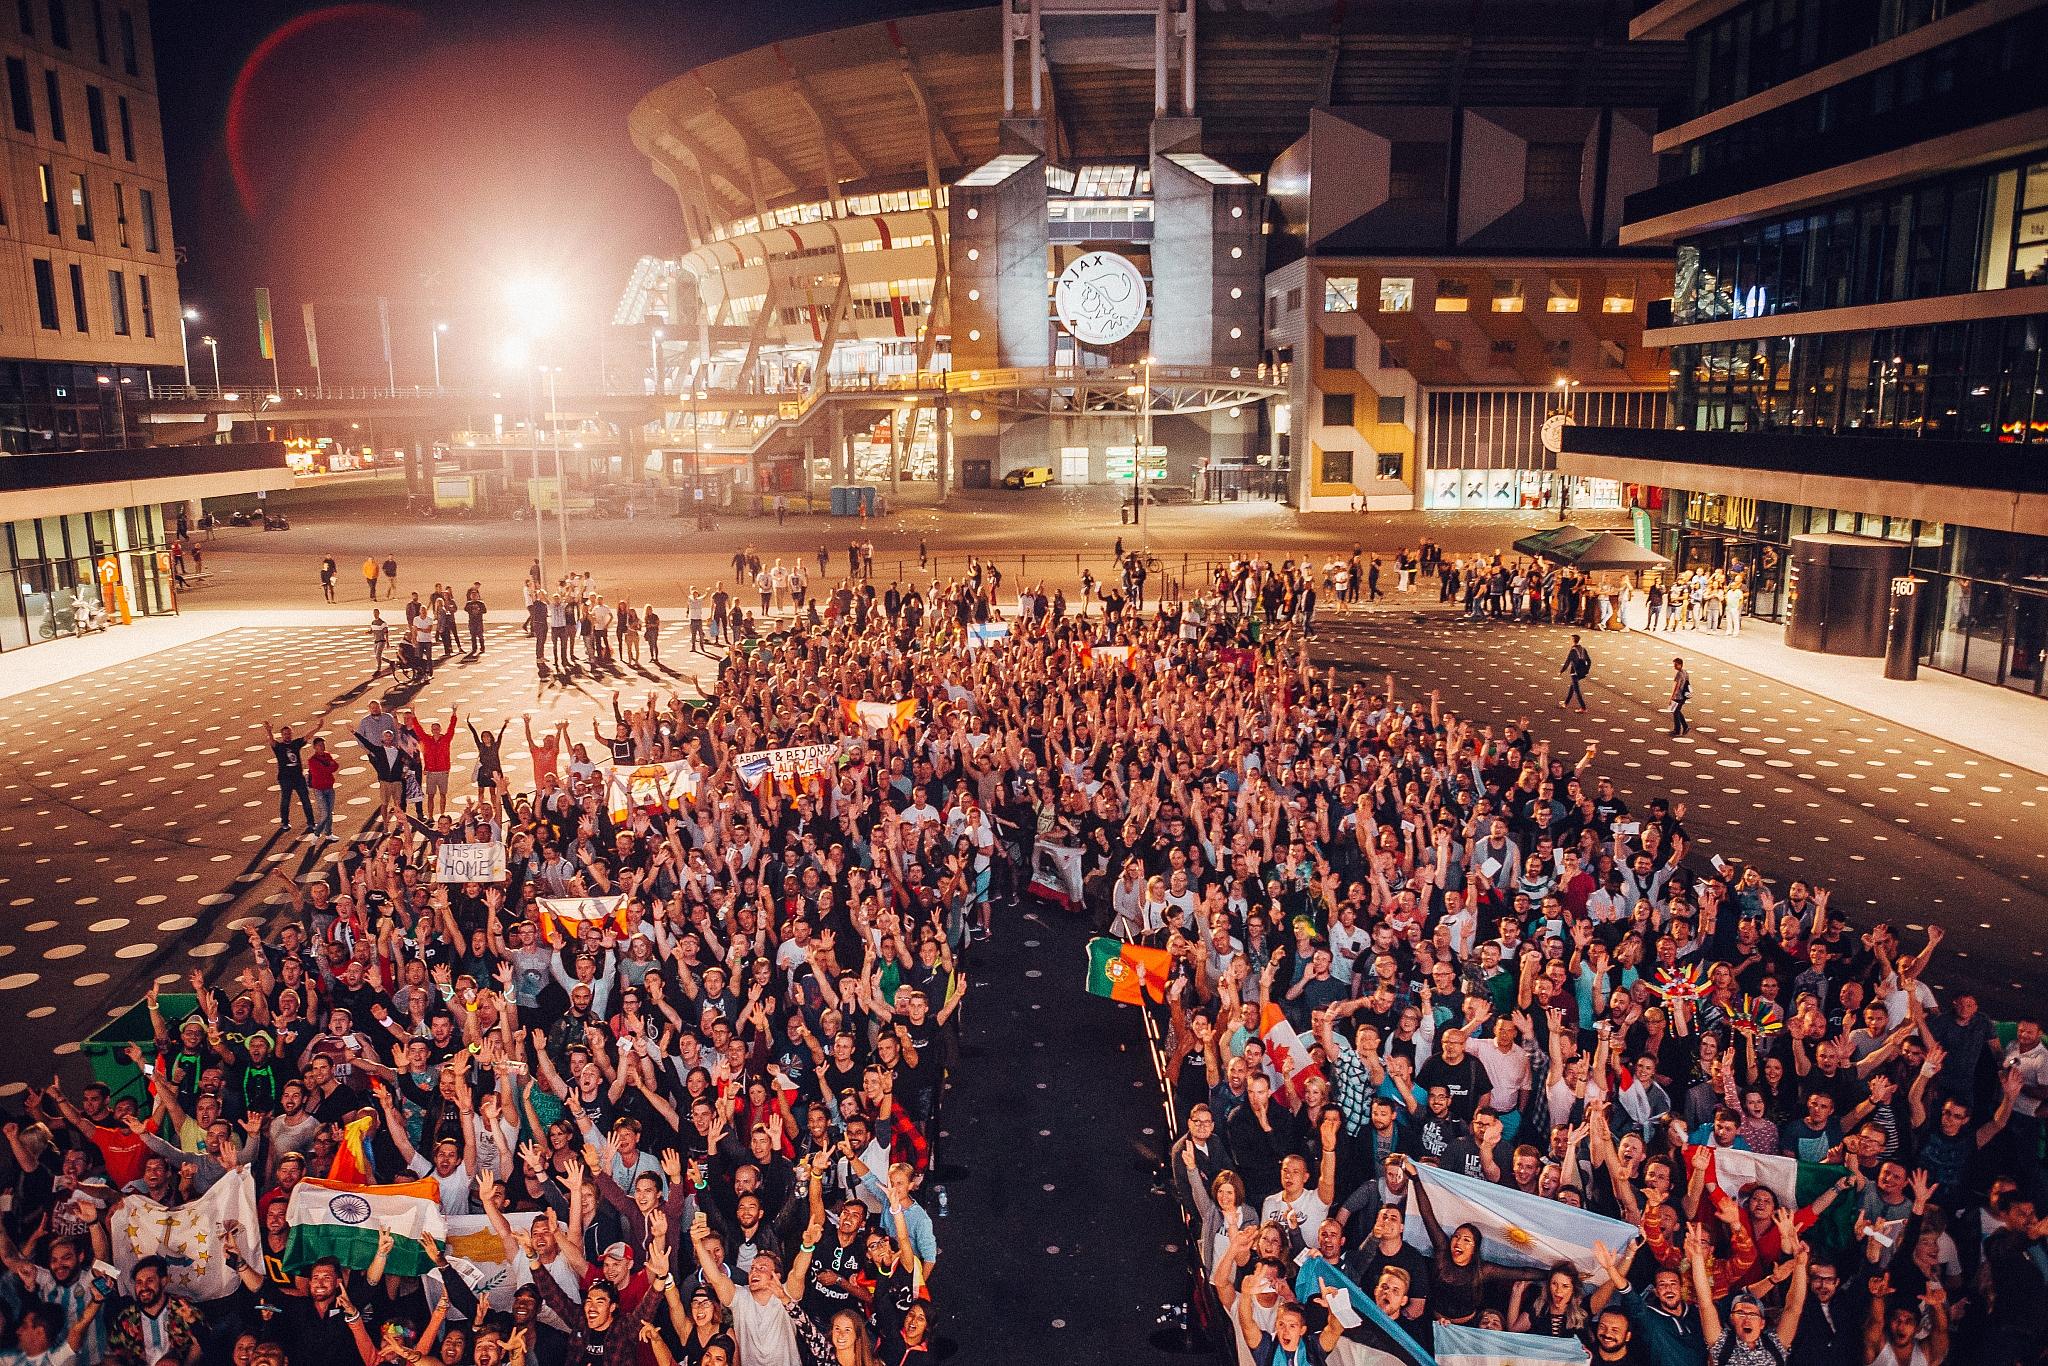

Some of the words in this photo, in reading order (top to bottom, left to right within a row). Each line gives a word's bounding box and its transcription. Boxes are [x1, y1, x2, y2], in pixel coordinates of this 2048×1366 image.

[1063, 256, 1102, 289] AJAX
[775, 751, 783, 762] &
[445, 859, 490, 877] HOME
